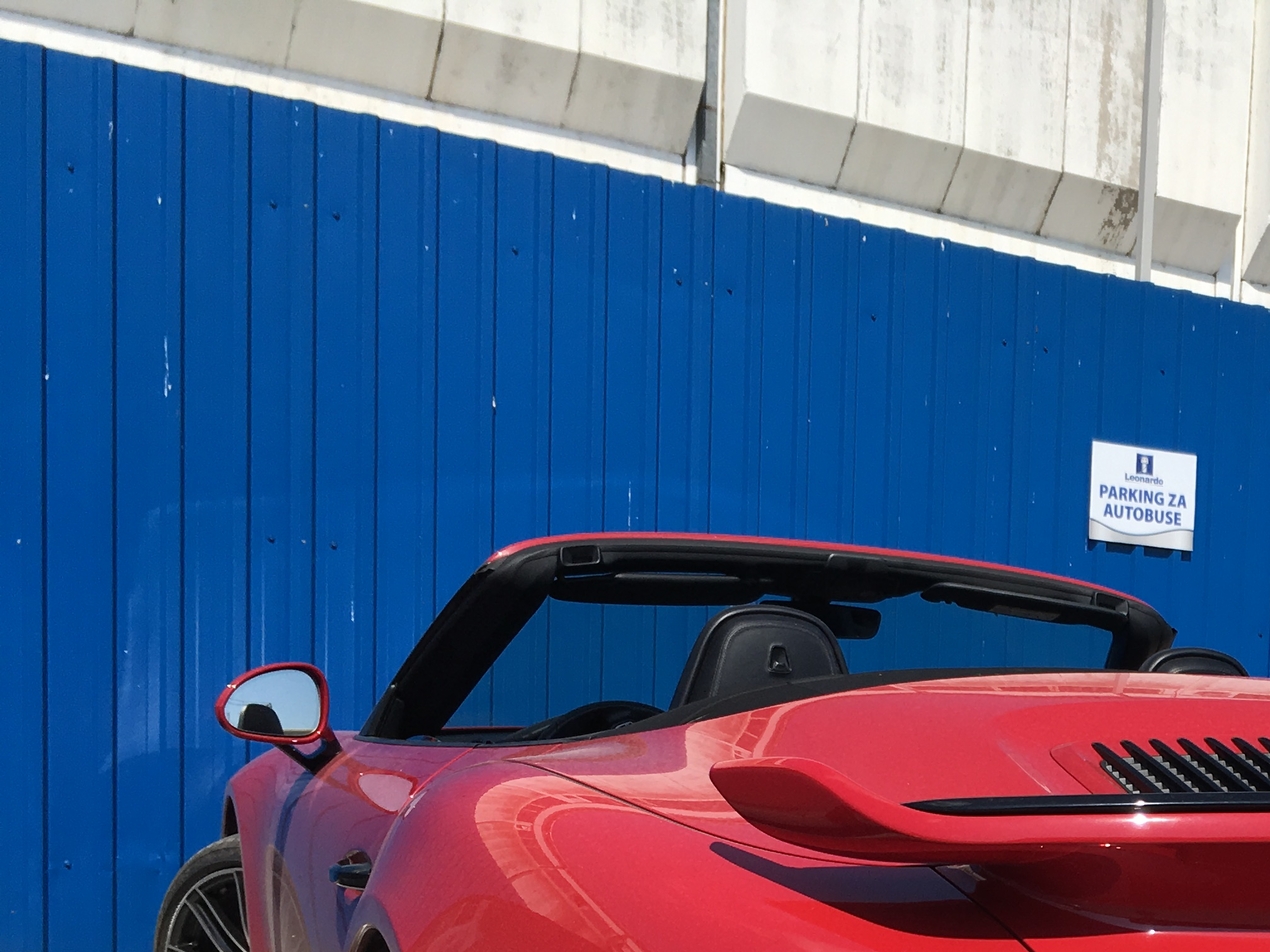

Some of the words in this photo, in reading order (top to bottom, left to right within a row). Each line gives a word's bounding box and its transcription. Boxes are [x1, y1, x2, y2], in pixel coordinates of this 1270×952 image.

[1124, 473, 1164, 486] Leonardo
[1099, 484, 1164, 506] PARKING
[1168, 493, 1187, 509] ZA
[1103, 503, 1182, 526] AUTOBUSE
